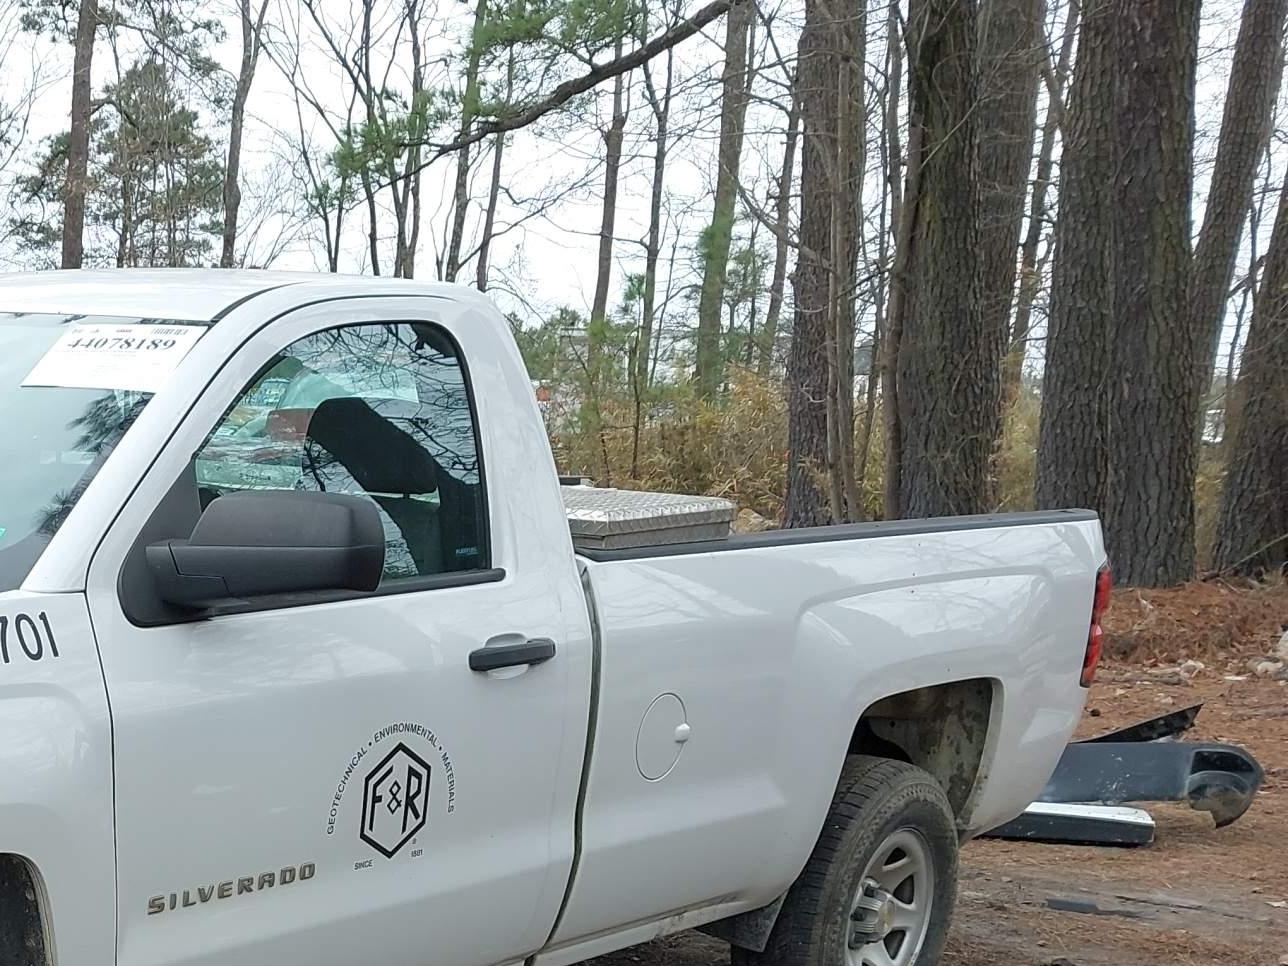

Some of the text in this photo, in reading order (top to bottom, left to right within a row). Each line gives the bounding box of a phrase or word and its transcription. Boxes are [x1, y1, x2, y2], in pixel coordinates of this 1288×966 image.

[68, 337, 176, 350] 44078189
[326, 722, 456, 835] GEOTECHNICAL ENVIRONMENTAL MATERIALS
[368, 764, 423, 835] F&R
[147, 862, 316, 915] SILVERADO
[354, 860, 373, 870] SINCE
